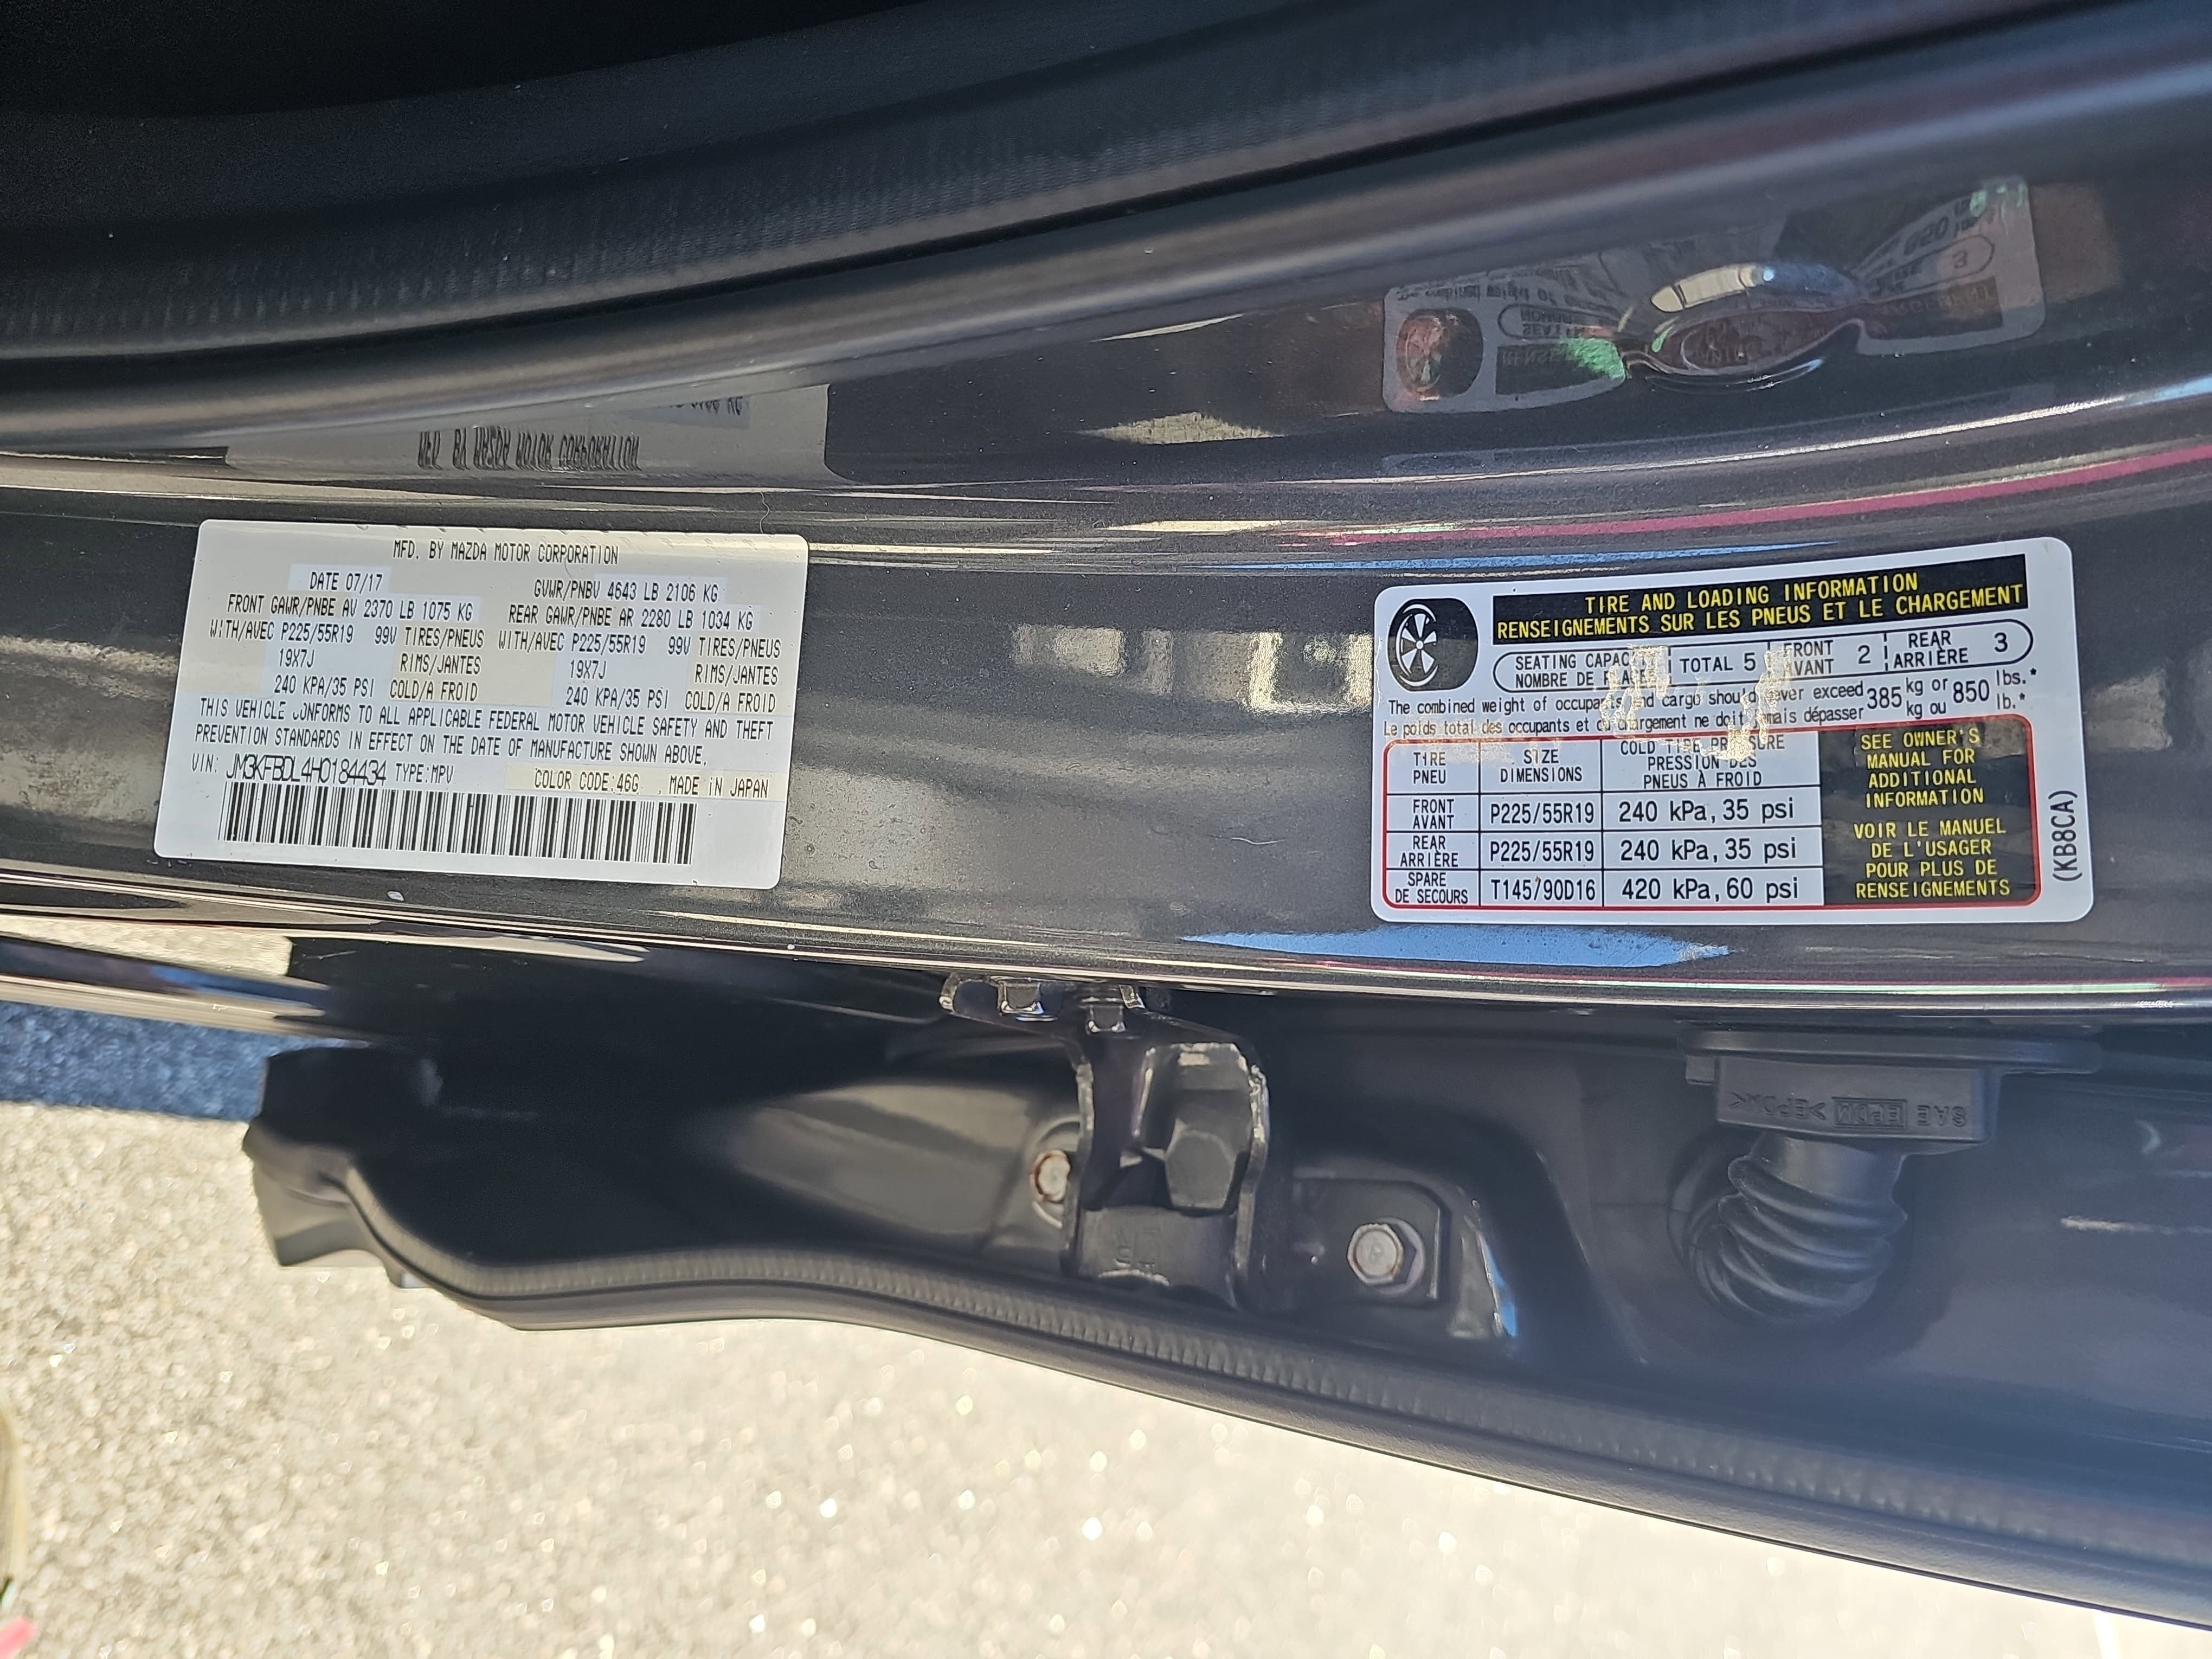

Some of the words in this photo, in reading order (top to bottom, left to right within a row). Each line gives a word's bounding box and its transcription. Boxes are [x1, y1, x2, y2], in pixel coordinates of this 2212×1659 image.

[394, 540, 419, 560] MFD.
[429, 541, 443, 559] BY
[451, 542, 486, 560] MAZDA
[494, 543, 530, 562] MOTOR
[538, 544, 618, 566] CORPORATION
[310, 572, 339, 590] DATE
[346, 573, 382, 594] 07/17
[535, 580, 600, 601] GVWR/PNBV
[608, 582, 636, 600] 4643
[644, 582, 659, 601] LB
[666, 583, 696, 602] 2106
[703, 584, 718, 602] KG
[1585, 594, 1628, 614] TIRE
[1642, 593, 1675, 610] AND
[1688, 586, 1769, 608] LOADING
[1785, 573, 1917, 600] INFORMATION
[228, 594, 265, 613] FRONT
[271, 596, 336, 618] GAWR/PNBE
[342, 599, 357, 616] AV
[364, 600, 393, 618] 2370
[400, 601, 414, 619] LB
[423, 601, 451, 620] 1075
[458, 603, 472, 621] KG
[509, 605, 538, 623] REAR
[546, 606, 612, 628] GAWR/PNBE
[619, 608, 633, 626] AR
[641, 609, 671, 628] 2280
[678, 610, 693, 628] LB
[703, 610, 730, 629] 1034
[738, 612, 753, 630] KG
[1498, 615, 1649, 638] RENSEIGNEMENTS
[1661, 613, 1694, 631] SUR
[1707, 610, 1740, 629] LES
[1752, 605, 1810, 625] PNEUS
[1824, 602, 1845, 620] ET
[1860, 599, 1880, 618] LE
[1896, 584, 2022, 614] CHARGEMENT
[281, 622, 353, 644] P225/55R19
[375, 626, 397, 644] 99V
[406, 627, 484, 650] TIRES/PNEUS
[1908, 631, 1951, 648] REAR
[1995, 633, 2008, 652] 3
[280, 648, 314, 667] 19X7J
[401, 653, 481, 676] RIMS/JANTES
[1516, 654, 1576, 670] SEATING
[1680, 657, 1733, 673] TOTAL
[1744, 652, 1756, 671] 5
[1858, 645, 1870, 664] 2
[1894, 647, 1968, 668] ARRIÈRE
[274, 675, 296, 693] 240
[303, 676, 347, 698] KPA/35
[353, 678, 374, 697] PSI
[1516, 672, 1567, 688] NOMBRE
[1577, 672, 1594, 686] DE
[390, 680, 433, 702] COLD/A
[441, 681, 477, 701] FROID
[1388, 700, 1410, 714] The
[1417, 698, 1475, 713] combined
[1482, 697, 1525, 715] weight
[1534, 696, 1547, 711] of
[1662, 694, 1700, 709] cargo
[1814, 680, 1863, 699] exceed
[1867, 686, 1901, 709] 385
[1906, 678, 1922, 696] kg
[1932, 678, 1947, 691] or
[1953, 679, 1989, 703] 850
[201, 698, 228, 717] THIS
[236, 699, 286, 719] VEHICLE
[359, 705, 372, 723] TO
[379, 706, 400, 724] ALL
[408, 708, 482, 728] APPLICABLE
[489, 711, 539, 731] FEDERAL
[548, 713, 585, 732] MOTOR
[594, 715, 645, 735] VEHICLE
[653, 717, 697, 737] SAFETY
[705, 719, 727, 738] AND
[737, 721, 773, 740] THEFT
[1509, 718, 1570, 736] occupants
[1577, 717, 1589, 731] et
[1695, 716, 1709, 728] ne
[1804, 706, 1863, 728] dépasser
[196, 724, 268, 745] PREVENTION
[275, 728, 340, 748] STANDARDS
[349, 731, 362, 749] IN
[369, 732, 413, 751] EFFECT
[420, 735, 435, 753] ON
[443, 735, 464, 754] THE
[471, 737, 501, 755] DATE
[509, 738, 523, 756] OF
[530, 739, 612, 760] MANUFACTURE
[620, 743, 657, 762] SHOWN
[665, 745, 706, 766] ABOVE.
[1621, 741, 1655, 755] COLD
[1861, 734, 1890, 750] SEE
[1904, 727, 1980, 747] OWNER'S
[192, 753, 218, 773] VIN:
[1648, 755, 1719, 771] PRESSION
[1867, 752, 1931, 769] MANUAL
[1943, 747, 1975, 763] FOR
[535, 768, 571, 789] COLOR
[670, 776, 699, 795] MADE
[730, 778, 768, 798] JAPAN
[1413, 769, 1445, 784] PNEU
[1501, 767, 1582, 782] DIMENSIONS
[1644, 774, 1687, 789] PNEUS
[1698, 770, 1706, 787] À
[1716, 771, 1761, 787] FROID
[1869, 769, 1977, 788] ADDITIONAL
[1413, 799, 1454, 813] FRONT
[1867, 788, 1983, 807] INFORMATION
[1491, 802, 1593, 824] P225/55R19
[1619, 801, 1657, 822] 240
[1670, 801, 1715, 823] kPa,
[1723, 799, 1748, 820] 35
[1762, 797, 1793, 824] psi
[1413, 815, 1454, 829] AVANT
[1854, 822, 1896, 839] VOIR
[1908, 821, 1929, 837] LE
[1940, 818, 2006, 835] MANUEL
[1413, 835, 1445, 850] REAR
[2048, 791, 2082, 881] (KB8CA)
[1400, 850, 1458, 867] ARRIÈRE
[1872, 843, 1891, 858] DE
[1904, 838, 1991, 857] L'USAGER
[1408, 872, 1446, 886] SPARE
[1866, 862, 1908, 878] POUR
[1921, 861, 1964, 876] PLUS
[1976, 859, 1995, 875] DE
[1396, 889, 1409, 903] DE
[1417, 889, 1468, 904] SECOURS
[1491, 877, 1595, 900] T145/90D16
[1622, 878, 1660, 899] 420
[1674, 878, 1719, 902] kPa,
[1727, 878, 1752, 899] 60
[1766, 877, 1797, 903] psi
[1856, 879, 2010, 898] RENSEIGNEMENTS
[1916, 1105, 1966, 1127] SAE
